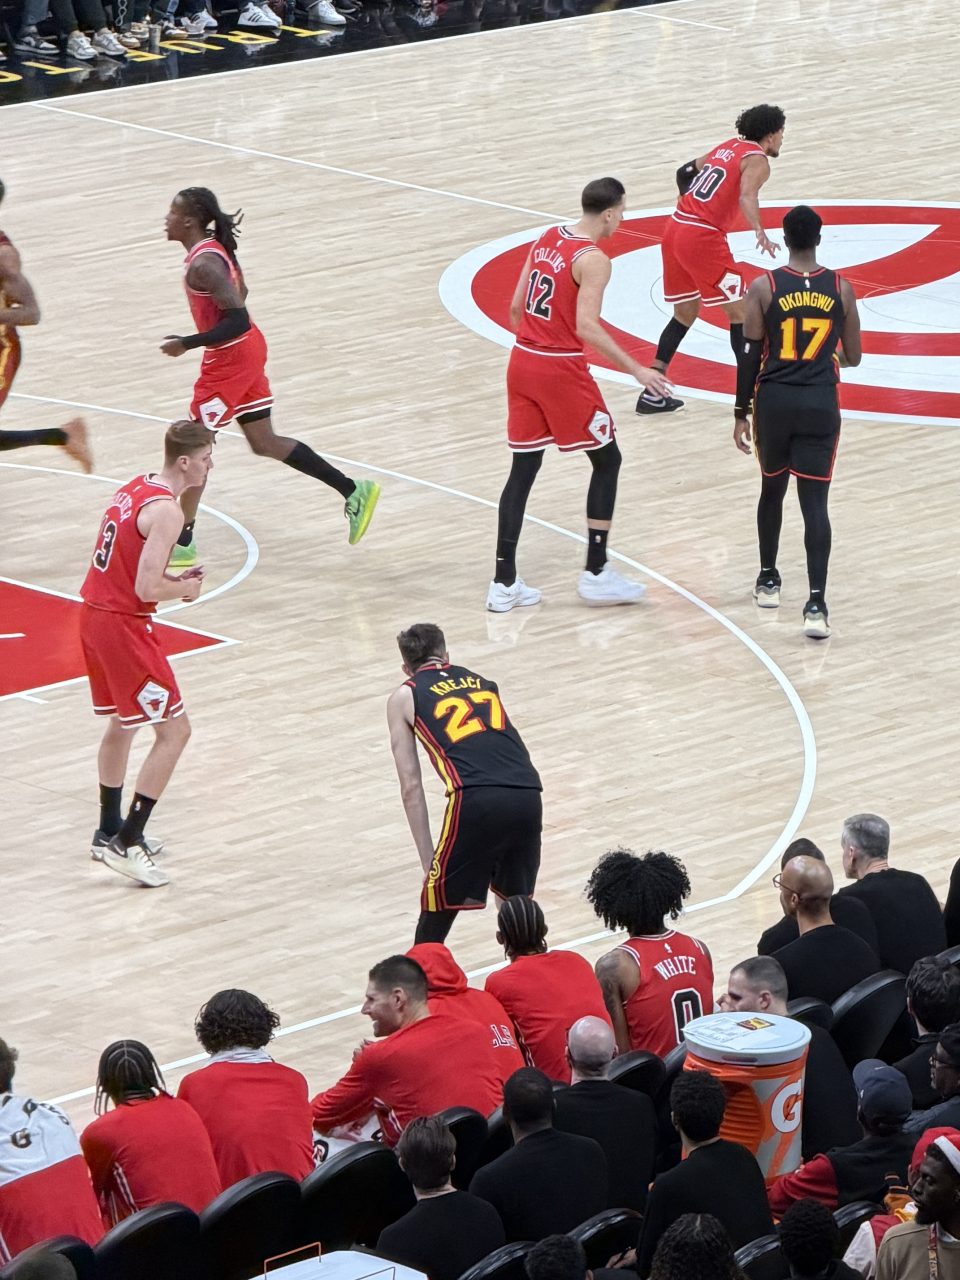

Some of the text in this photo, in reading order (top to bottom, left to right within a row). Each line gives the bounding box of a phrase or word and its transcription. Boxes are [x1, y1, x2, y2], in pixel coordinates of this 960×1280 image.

[534, 247, 566, 274] COLLINS
[525, 269, 555, 320] 12
[779, 291, 835, 313] OKONGWU
[780, 317, 833, 361] 17
[433, 690, 506, 743] 27
[654, 956, 696, 981] WHITE
[671, 987, 703, 1045] 0
